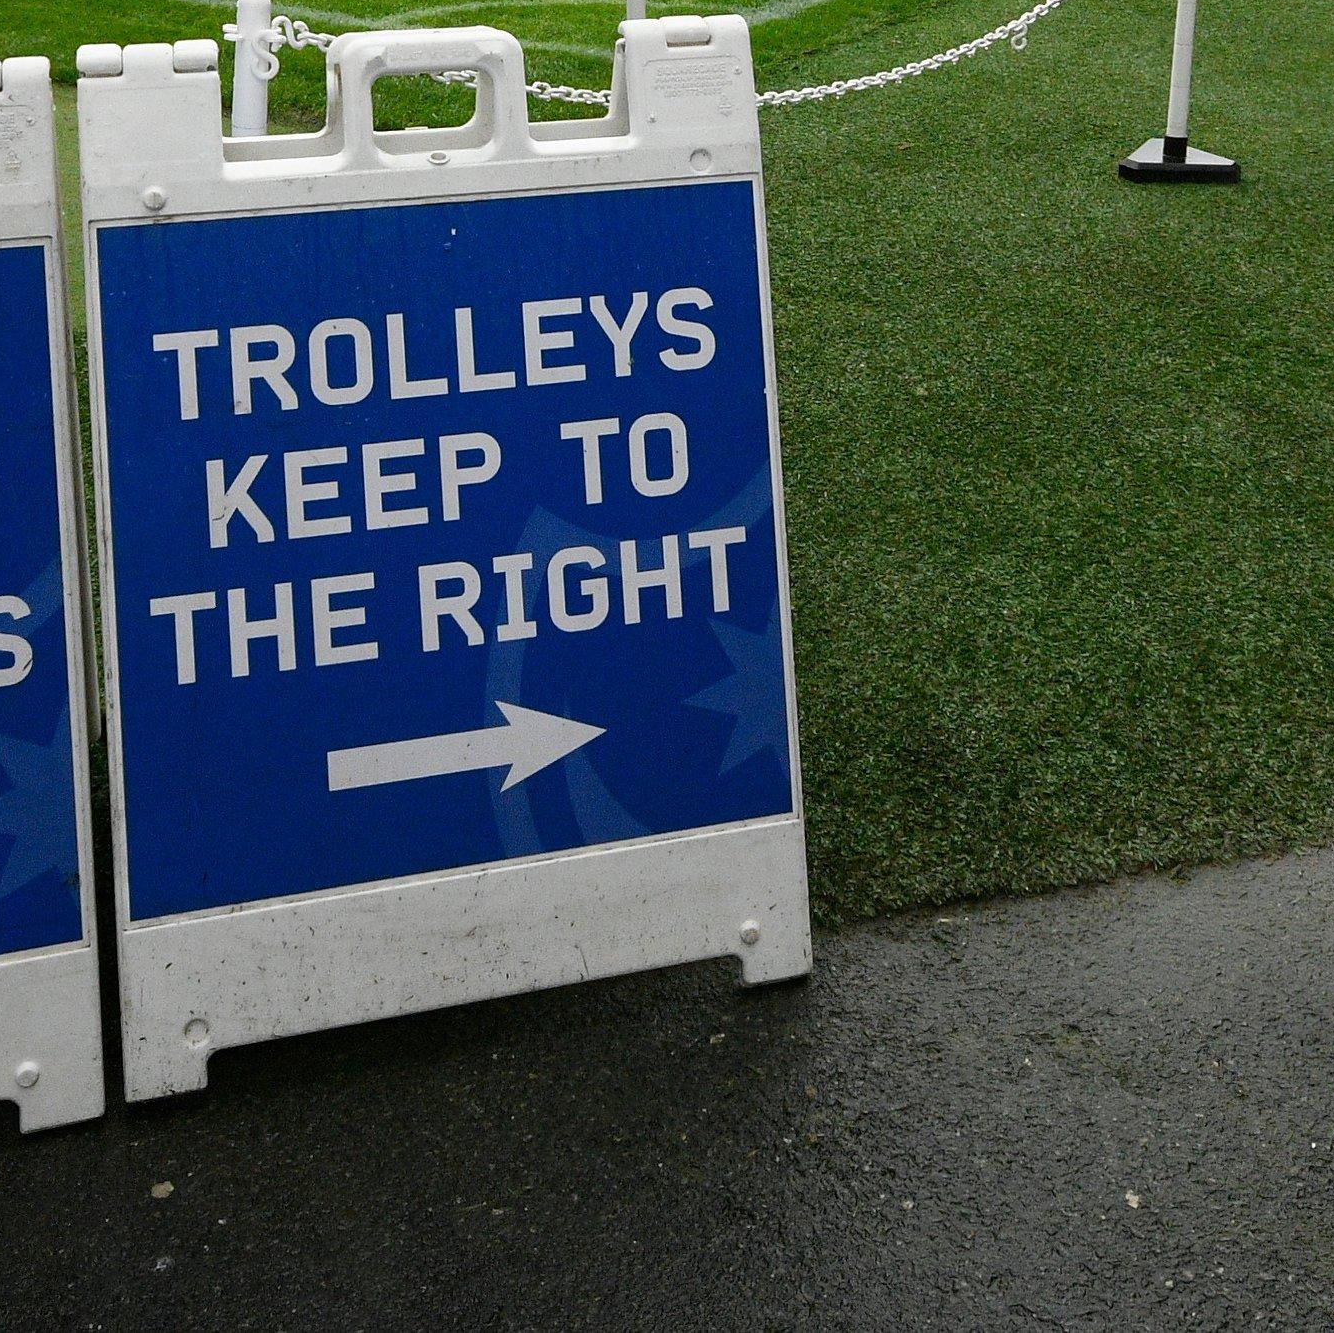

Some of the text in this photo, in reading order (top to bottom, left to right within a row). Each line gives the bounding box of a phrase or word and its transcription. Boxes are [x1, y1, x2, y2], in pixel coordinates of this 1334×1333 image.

[152, 287, 716, 422] TROLLEYS
[205, 412, 690, 549] KEEP TO
[149, 526, 748, 686] THE RIGHT
